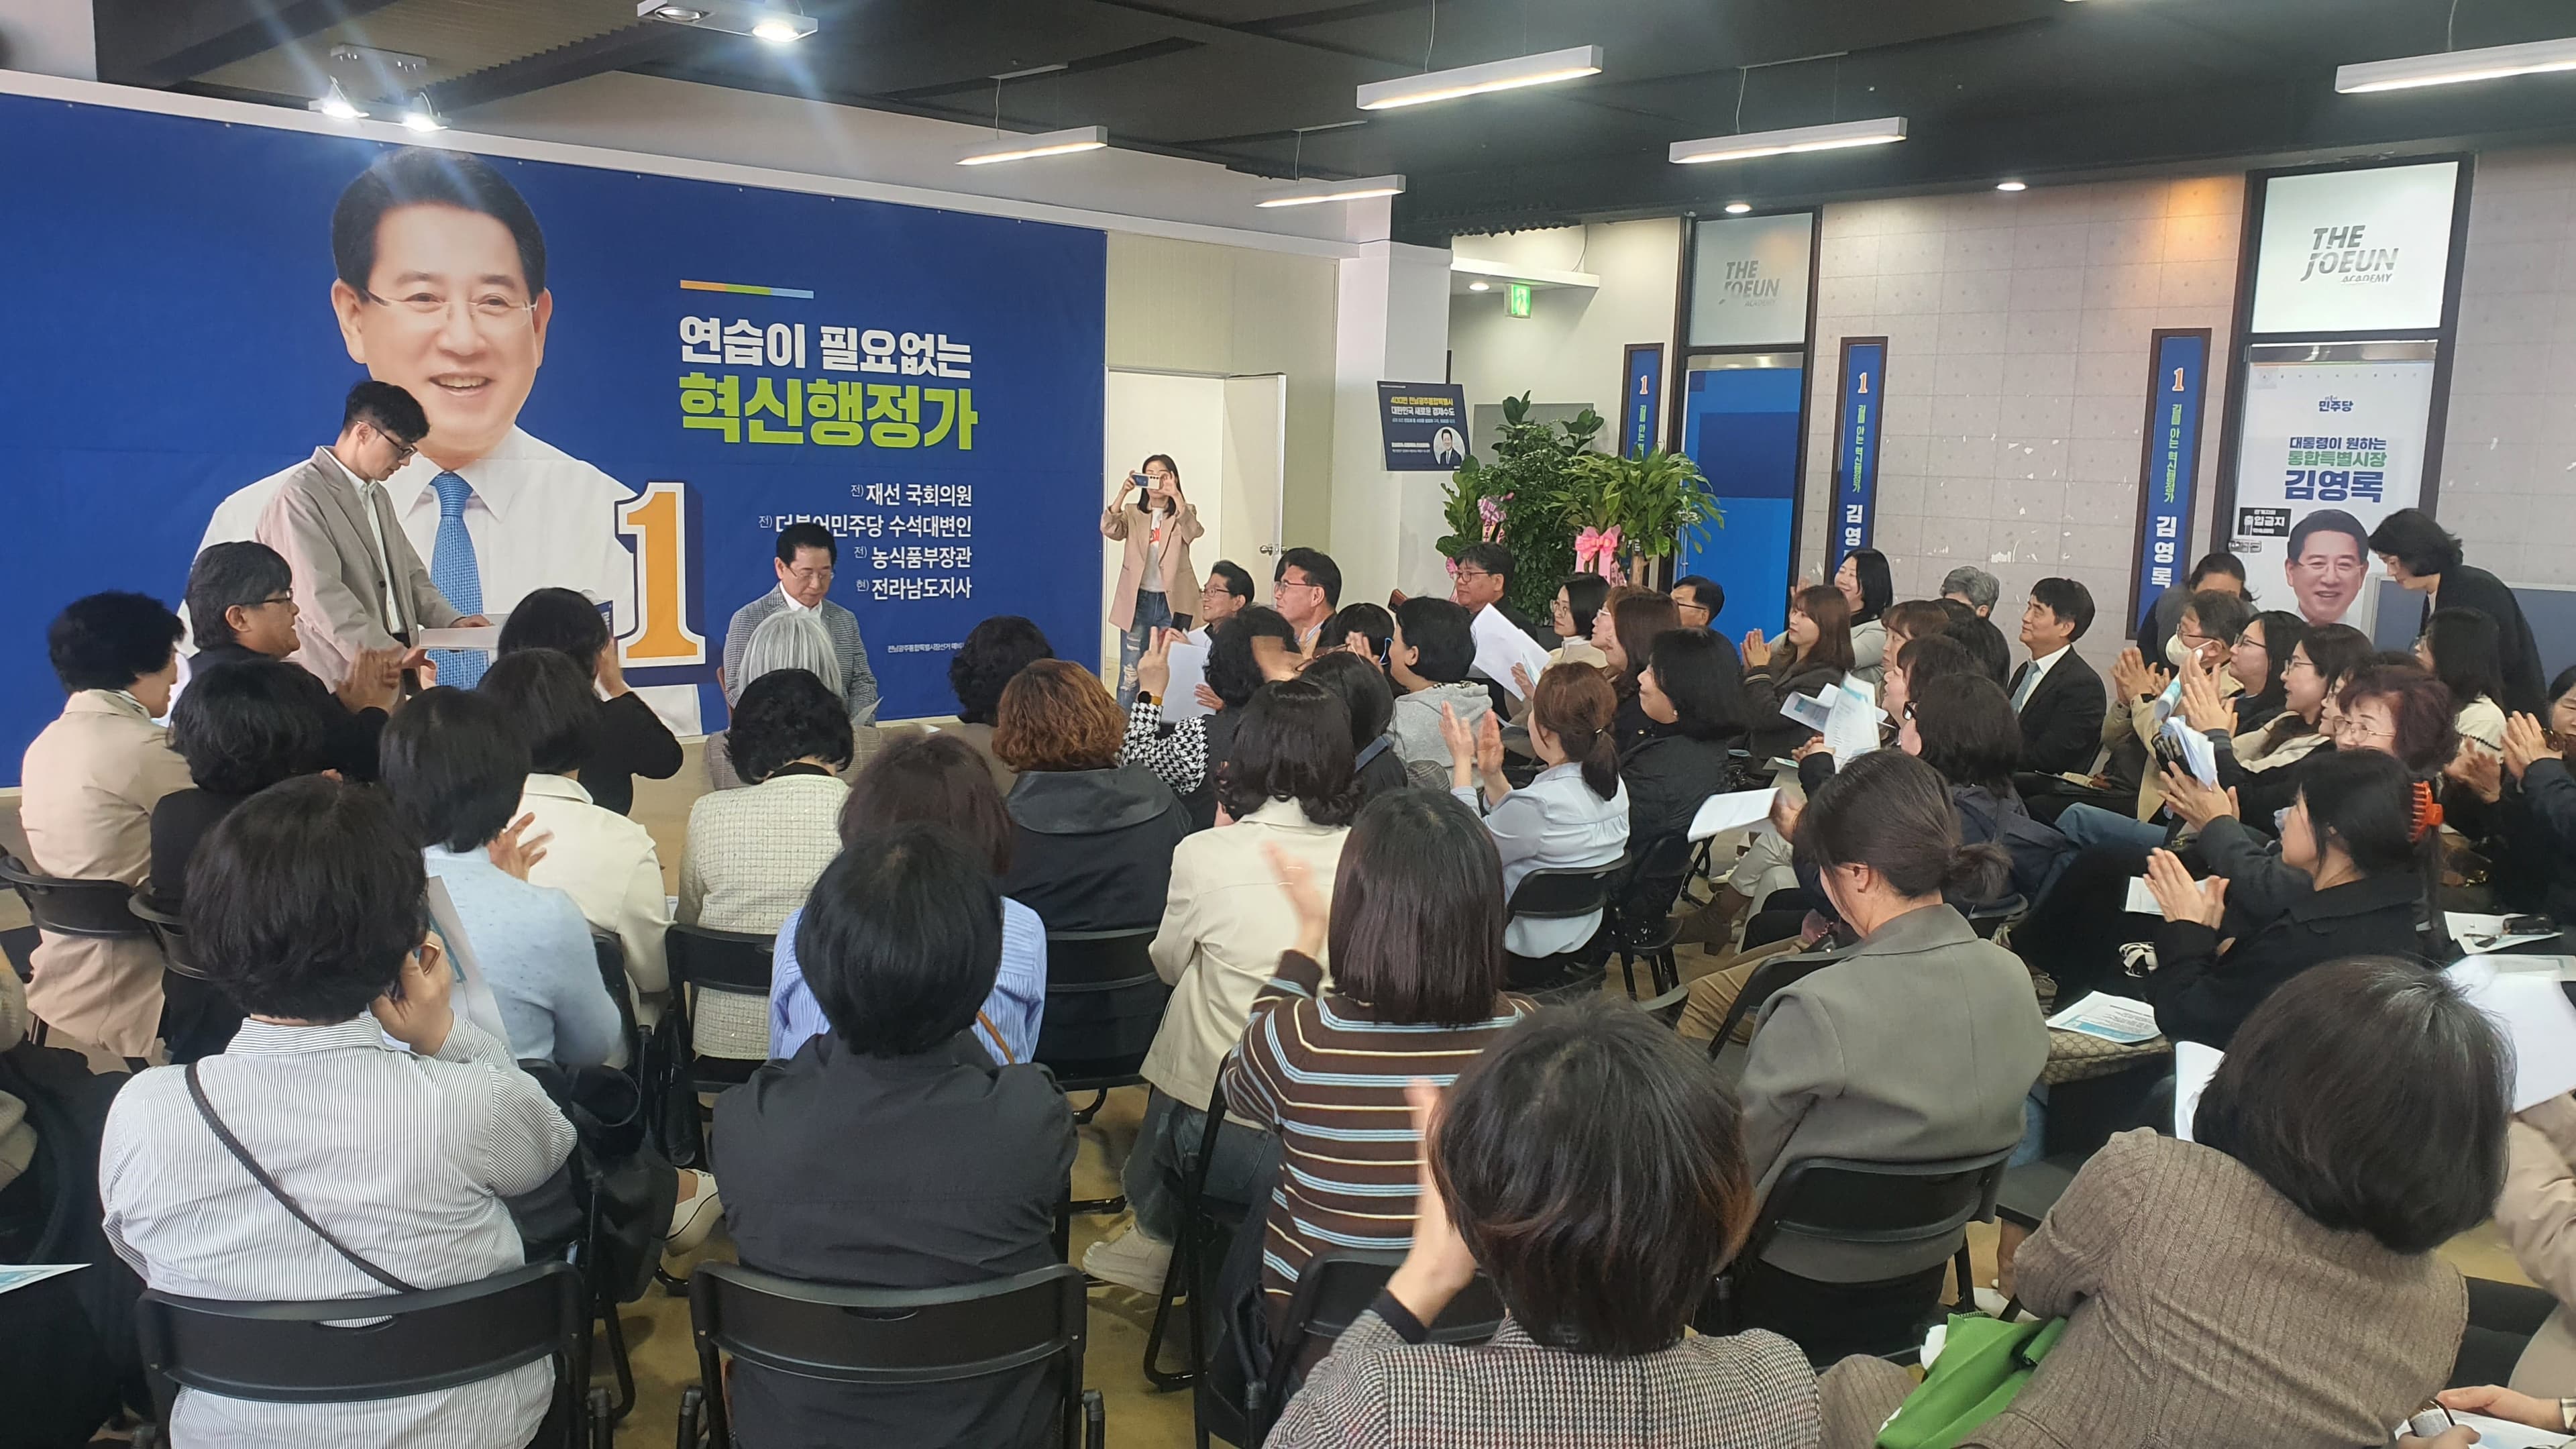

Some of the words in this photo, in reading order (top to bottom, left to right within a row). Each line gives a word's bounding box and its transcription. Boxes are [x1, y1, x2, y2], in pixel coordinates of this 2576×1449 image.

[2313, 225, 2365, 250] THE
[1726, 260, 1759, 279] THE
[2300, 248, 2399, 282] JOEUN
[2341, 273, 2392, 282] ACADEMY
[680, 315, 805, 368] 연습이
[820, 325, 971, 379] 필요없는
[1640, 376, 1648, 394] 1
[1858, 372, 1868, 394] 1
[2172, 368, 2184, 392] 1
[679, 372, 979, 450] 혁신행정가
[2318, 400, 2354, 412] 민주당
[2289, 437, 2342, 450] 대통령이
[2346, 437, 2387, 451] 원하는
[2288, 450, 2387, 468] 통합특별시장
[866, 482, 901, 506] 재선
[906, 483, 972, 506] 국회의원
[2285, 470, 2383, 503] 김영록
[889, 515, 972, 538] 수석대변인
[1843, 504, 1863, 559] 김영
[871, 545, 972, 569] 농식품부장관
[2151, 516, 2177, 588] 김영록
[618, 482, 706, 667] 1
[871, 576, 972, 600] 전라남도지사
